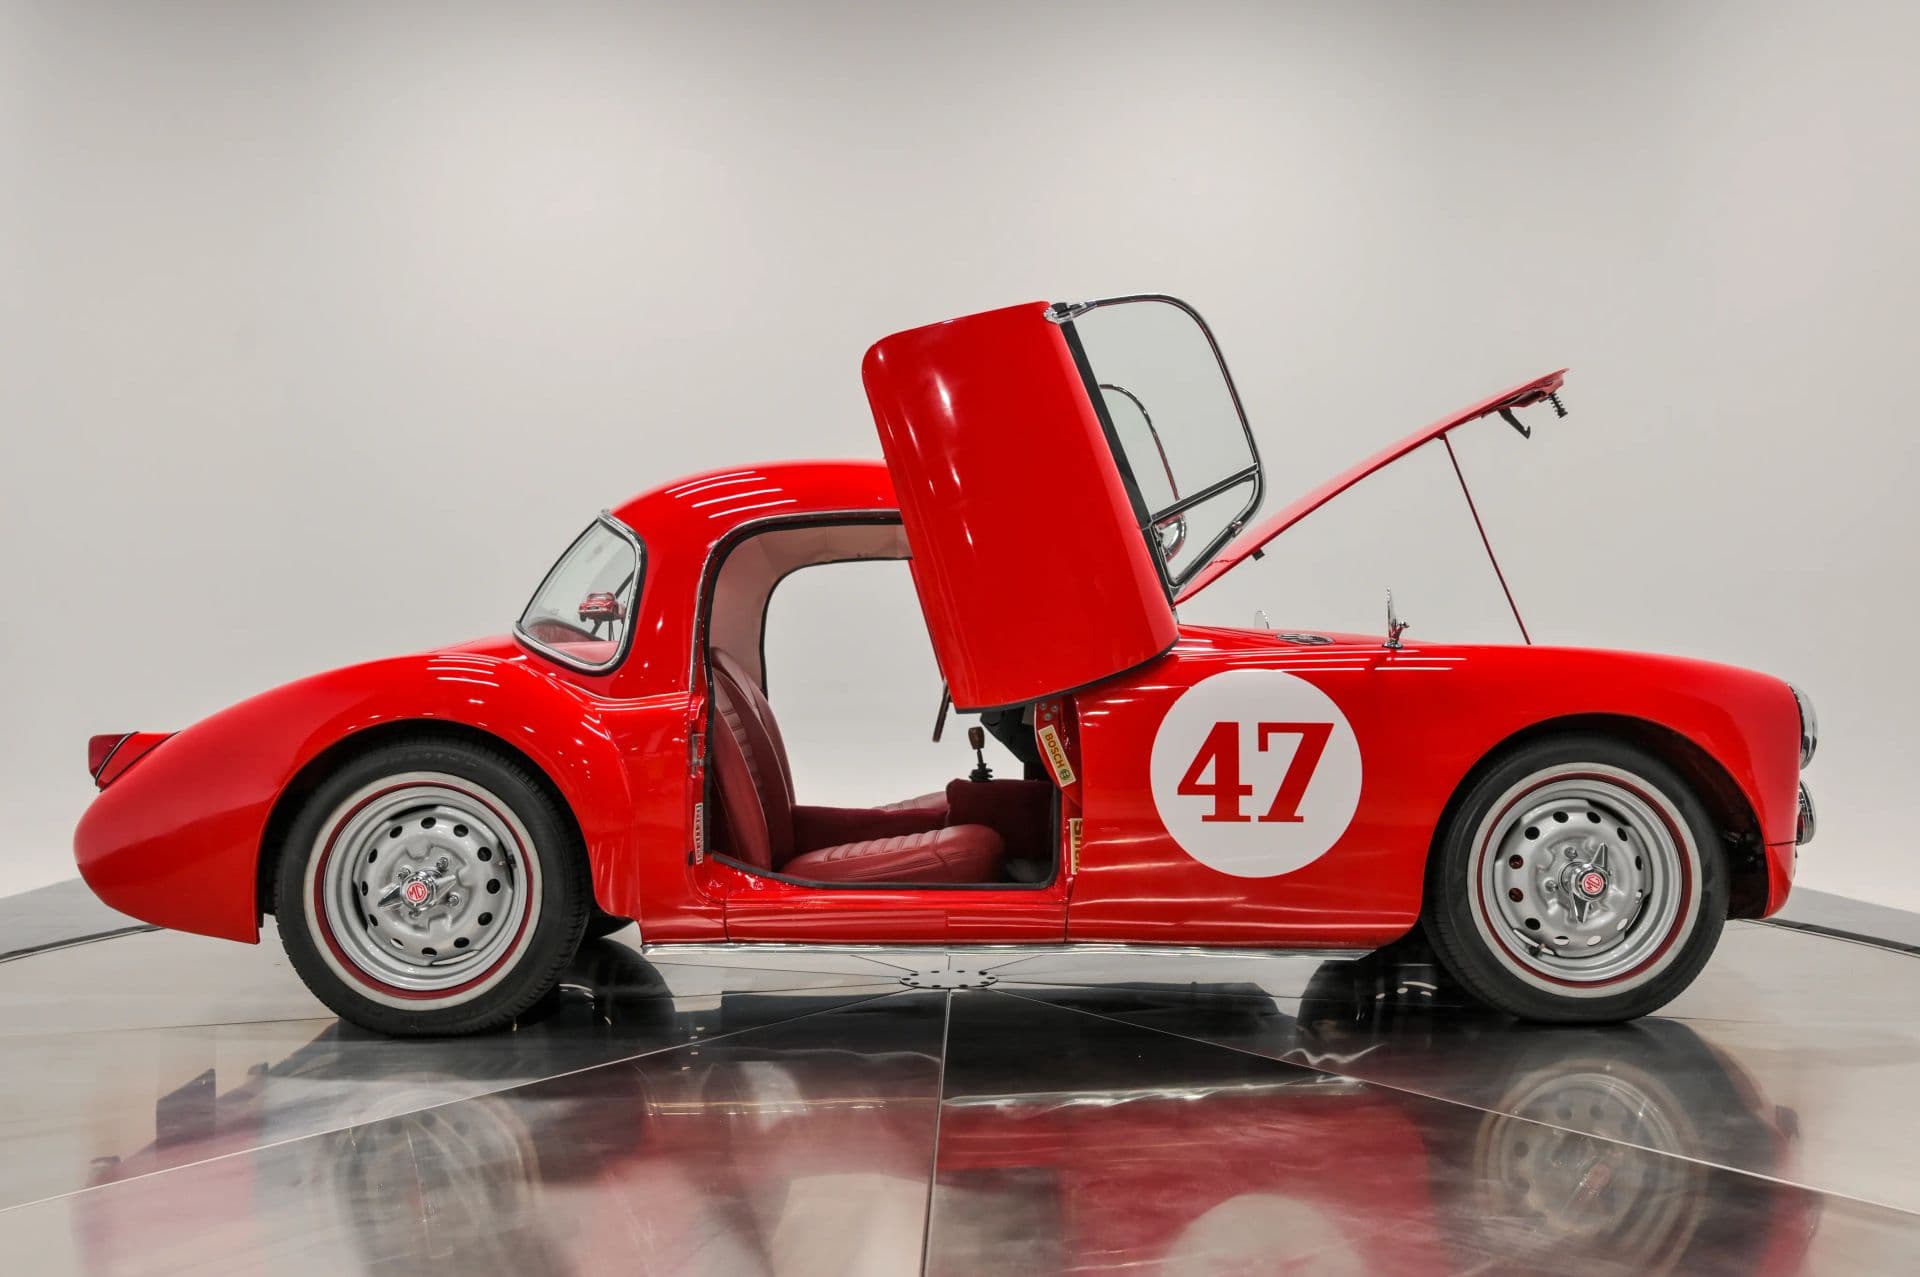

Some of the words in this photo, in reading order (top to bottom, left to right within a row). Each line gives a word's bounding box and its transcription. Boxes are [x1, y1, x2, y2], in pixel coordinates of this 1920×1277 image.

[1044, 732, 1065, 769] BOSCH
[1177, 721, 1335, 823] 47
[409, 885, 425, 900] MG
